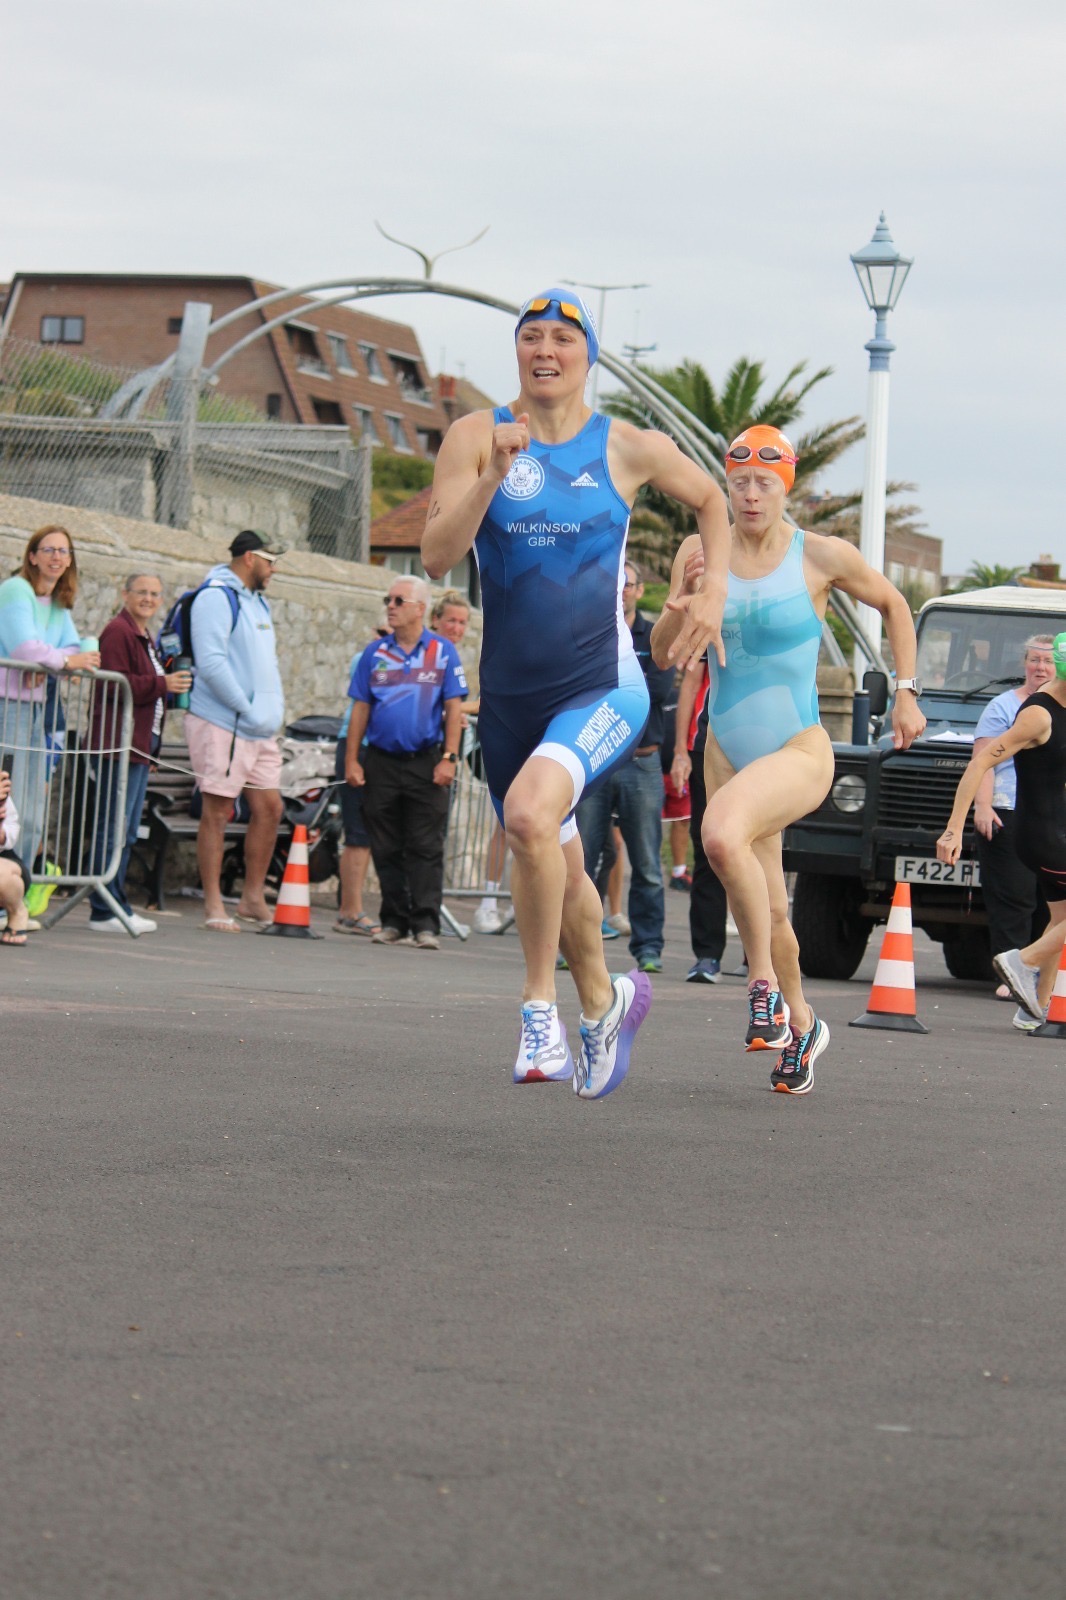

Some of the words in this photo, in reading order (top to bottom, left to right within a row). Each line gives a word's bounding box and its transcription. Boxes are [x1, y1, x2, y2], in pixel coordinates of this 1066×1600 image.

[509, 460, 539, 475] ORKSHIRE
[507, 522, 581, 533] WILKINSON
[528, 536, 556, 547] GBR
[575, 701, 621, 756] YORKSHIRE
[589, 736, 615, 773] BIATHLE
[609, 719, 632, 748] CLUB
[990, 744, 1006, 758] 3
[937, 760, 955, 768] LAND
[903, 860, 955, 881] F422
